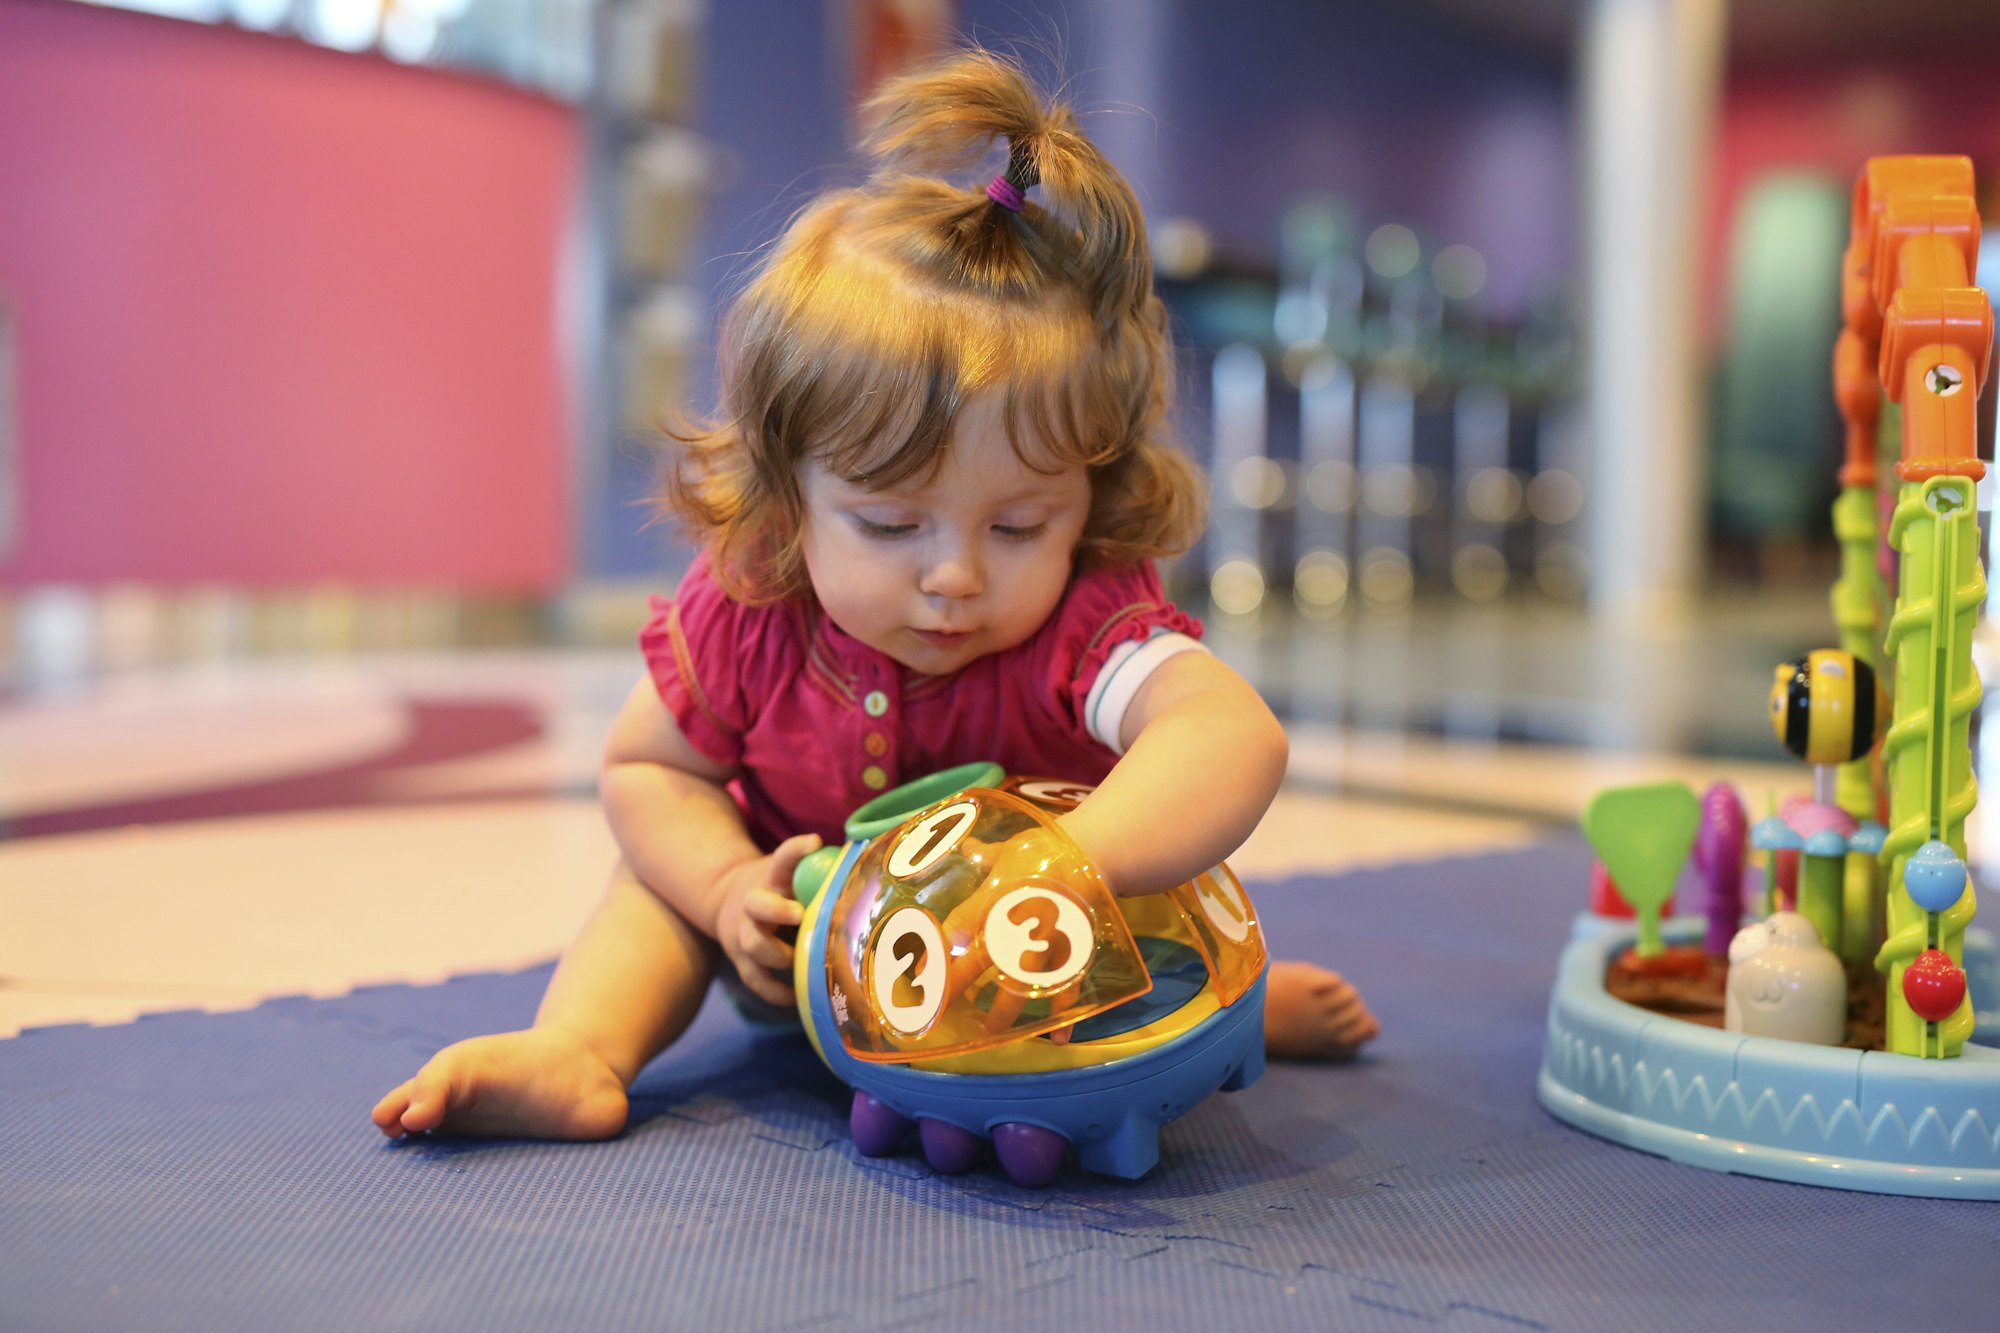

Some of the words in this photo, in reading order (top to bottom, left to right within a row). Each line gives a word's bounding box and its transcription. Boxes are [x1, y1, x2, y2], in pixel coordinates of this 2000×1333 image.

[909, 812, 966, 867] 1
[1197, 871, 1244, 924] 1
[1007, 896, 1072, 973] 3
[891, 931, 928, 1008] 2
